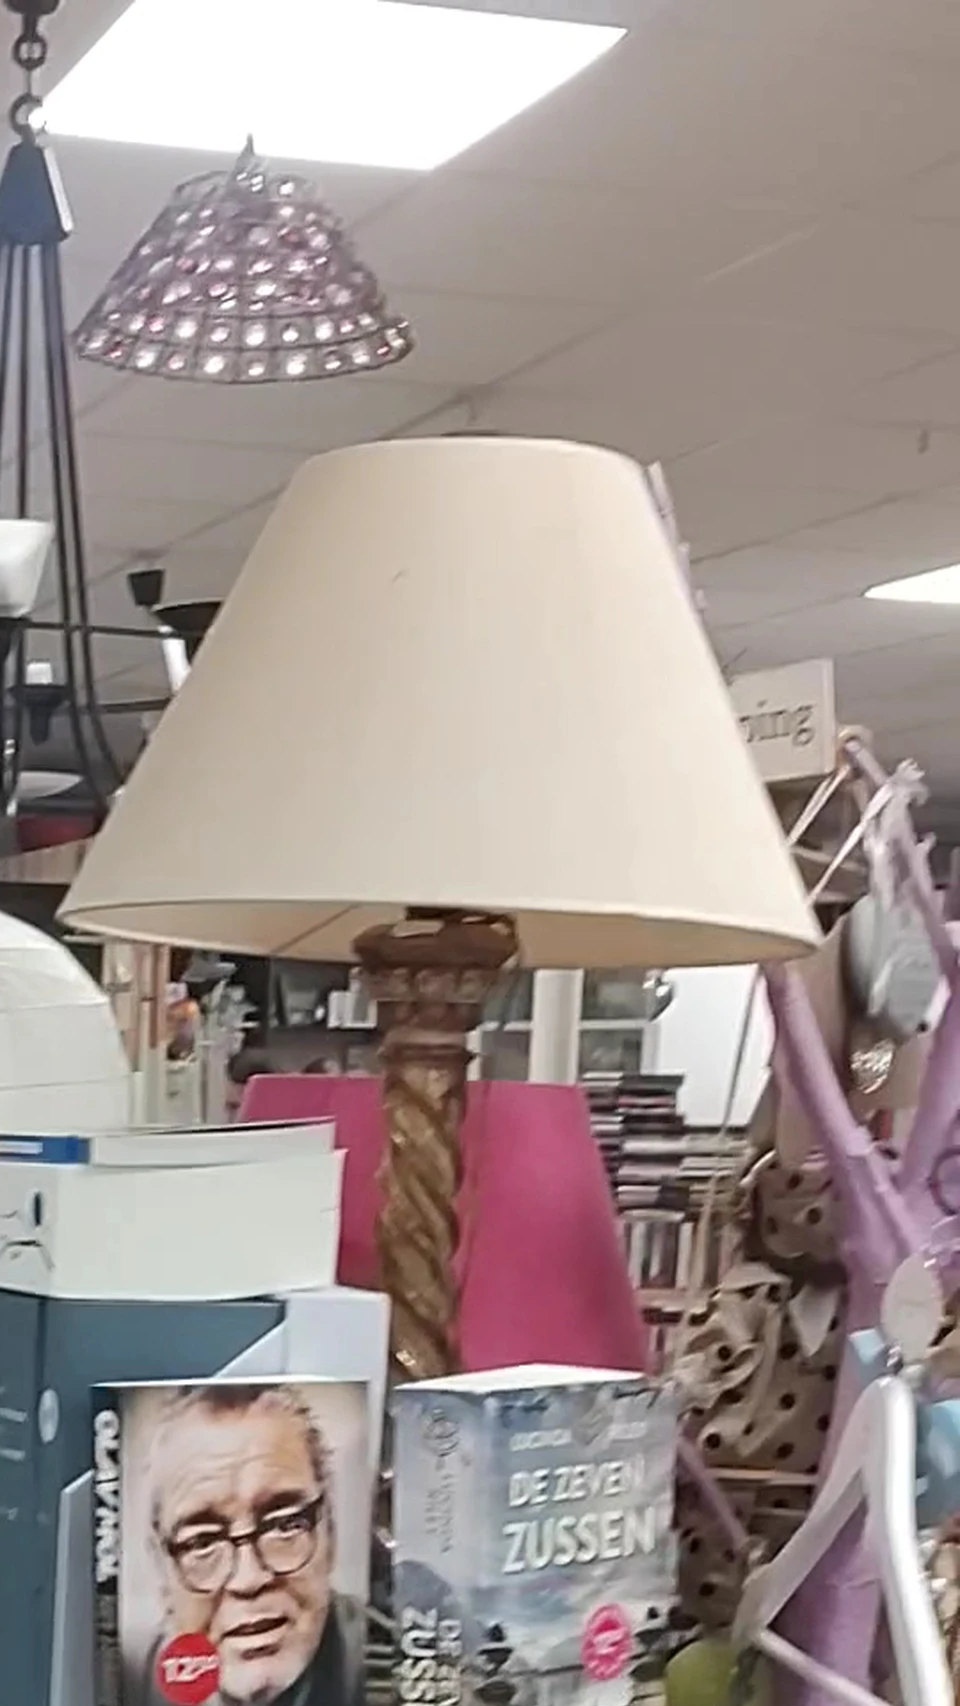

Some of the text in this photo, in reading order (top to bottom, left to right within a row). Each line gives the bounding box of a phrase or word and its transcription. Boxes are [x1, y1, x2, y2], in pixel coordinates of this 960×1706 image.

[508, 1452, 645, 1508] DE ZEVEN
[501, 1505, 656, 1575] ZUSSEN
